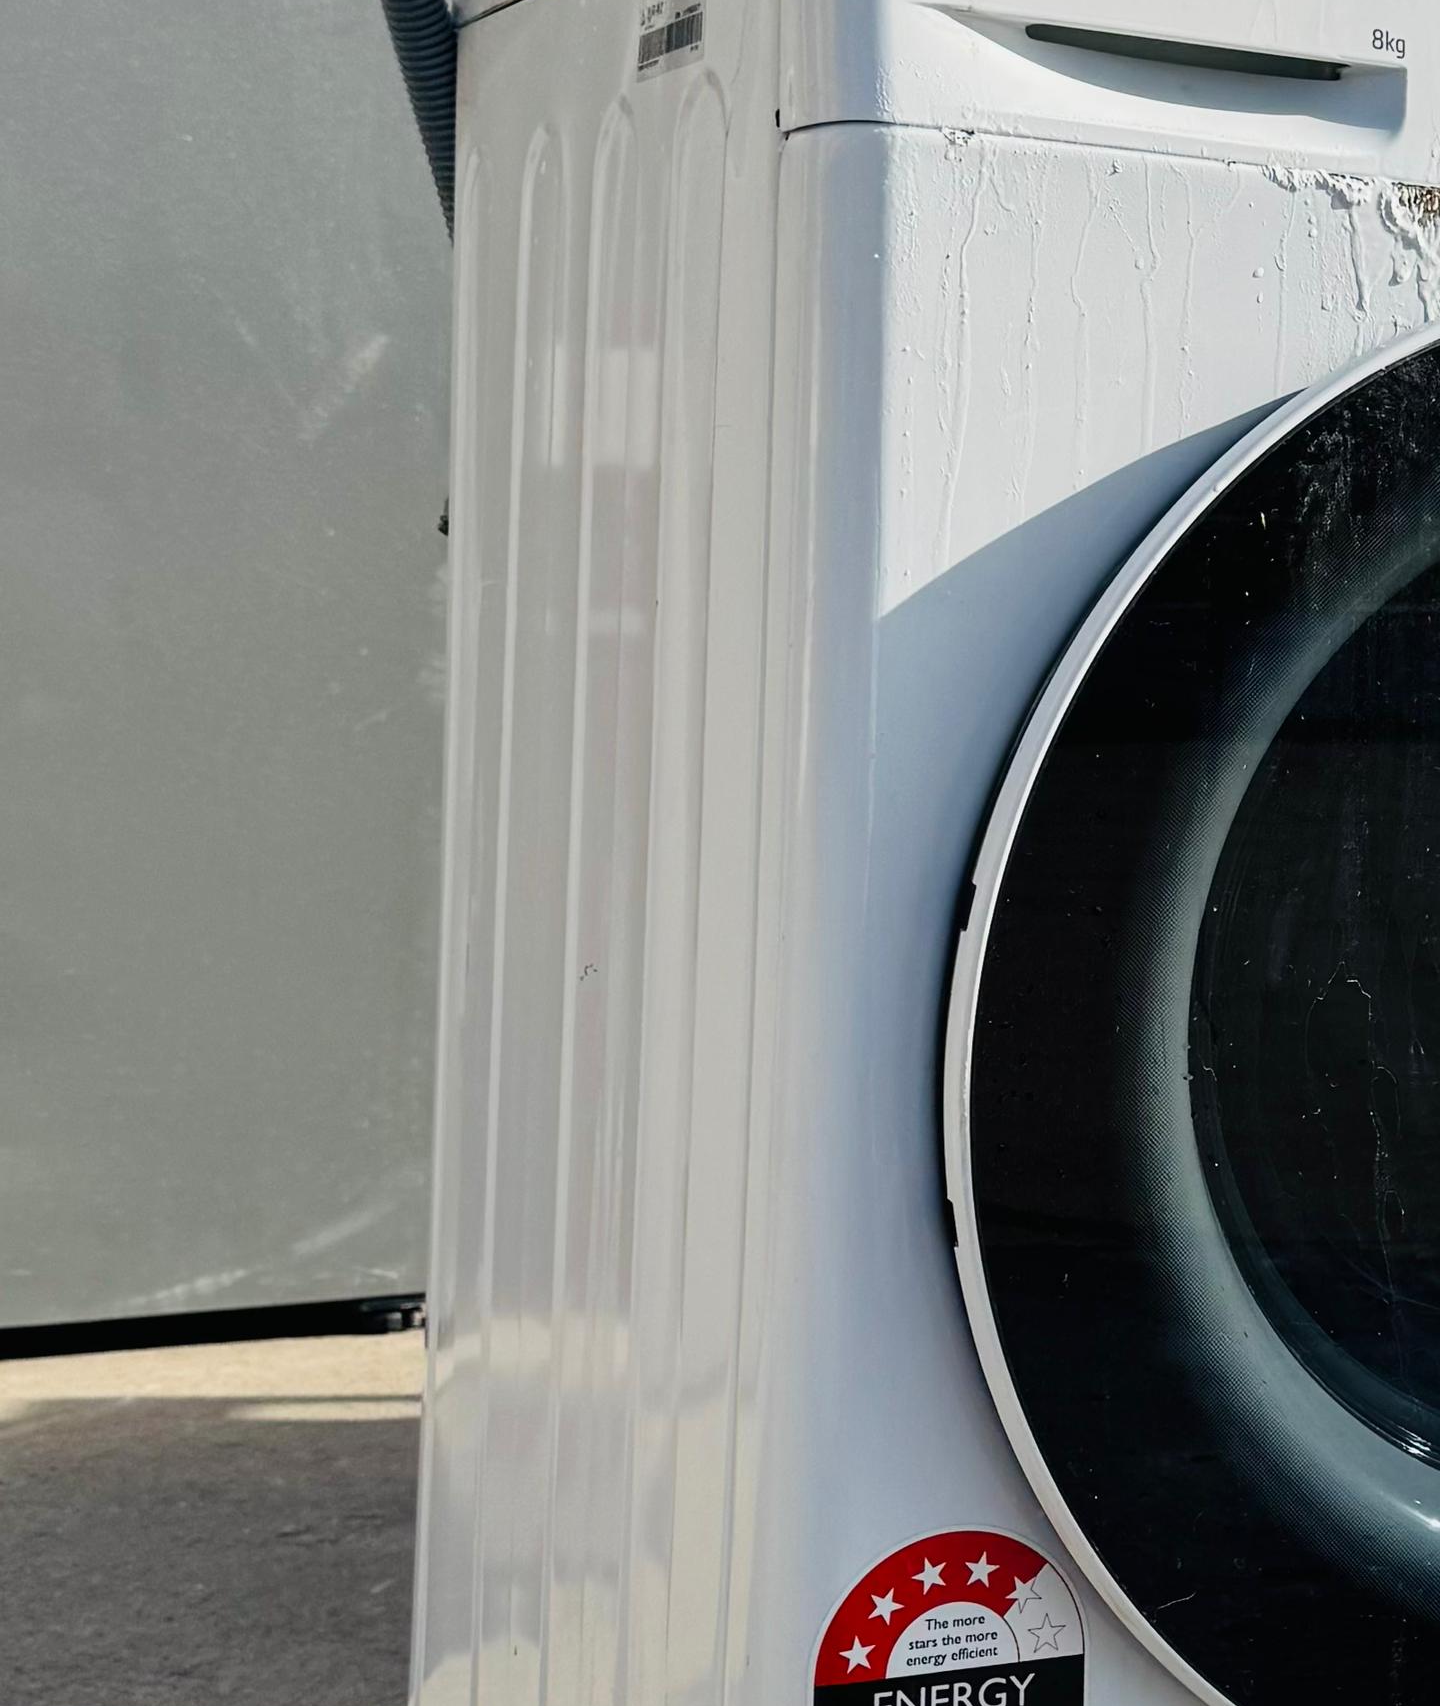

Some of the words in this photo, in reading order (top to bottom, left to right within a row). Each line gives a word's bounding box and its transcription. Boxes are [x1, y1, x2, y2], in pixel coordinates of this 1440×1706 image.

[1371, 29, 1406, 59] 8kg
[925, 1618, 950, 1631] The
[953, 1615, 985, 1627] more
[908, 1637, 937, 1651] stars
[942, 1634, 961, 1646] the
[965, 1630, 998, 1642] more
[906, 1652, 947, 1667] energy
[951, 1646, 999, 1661] efficient
